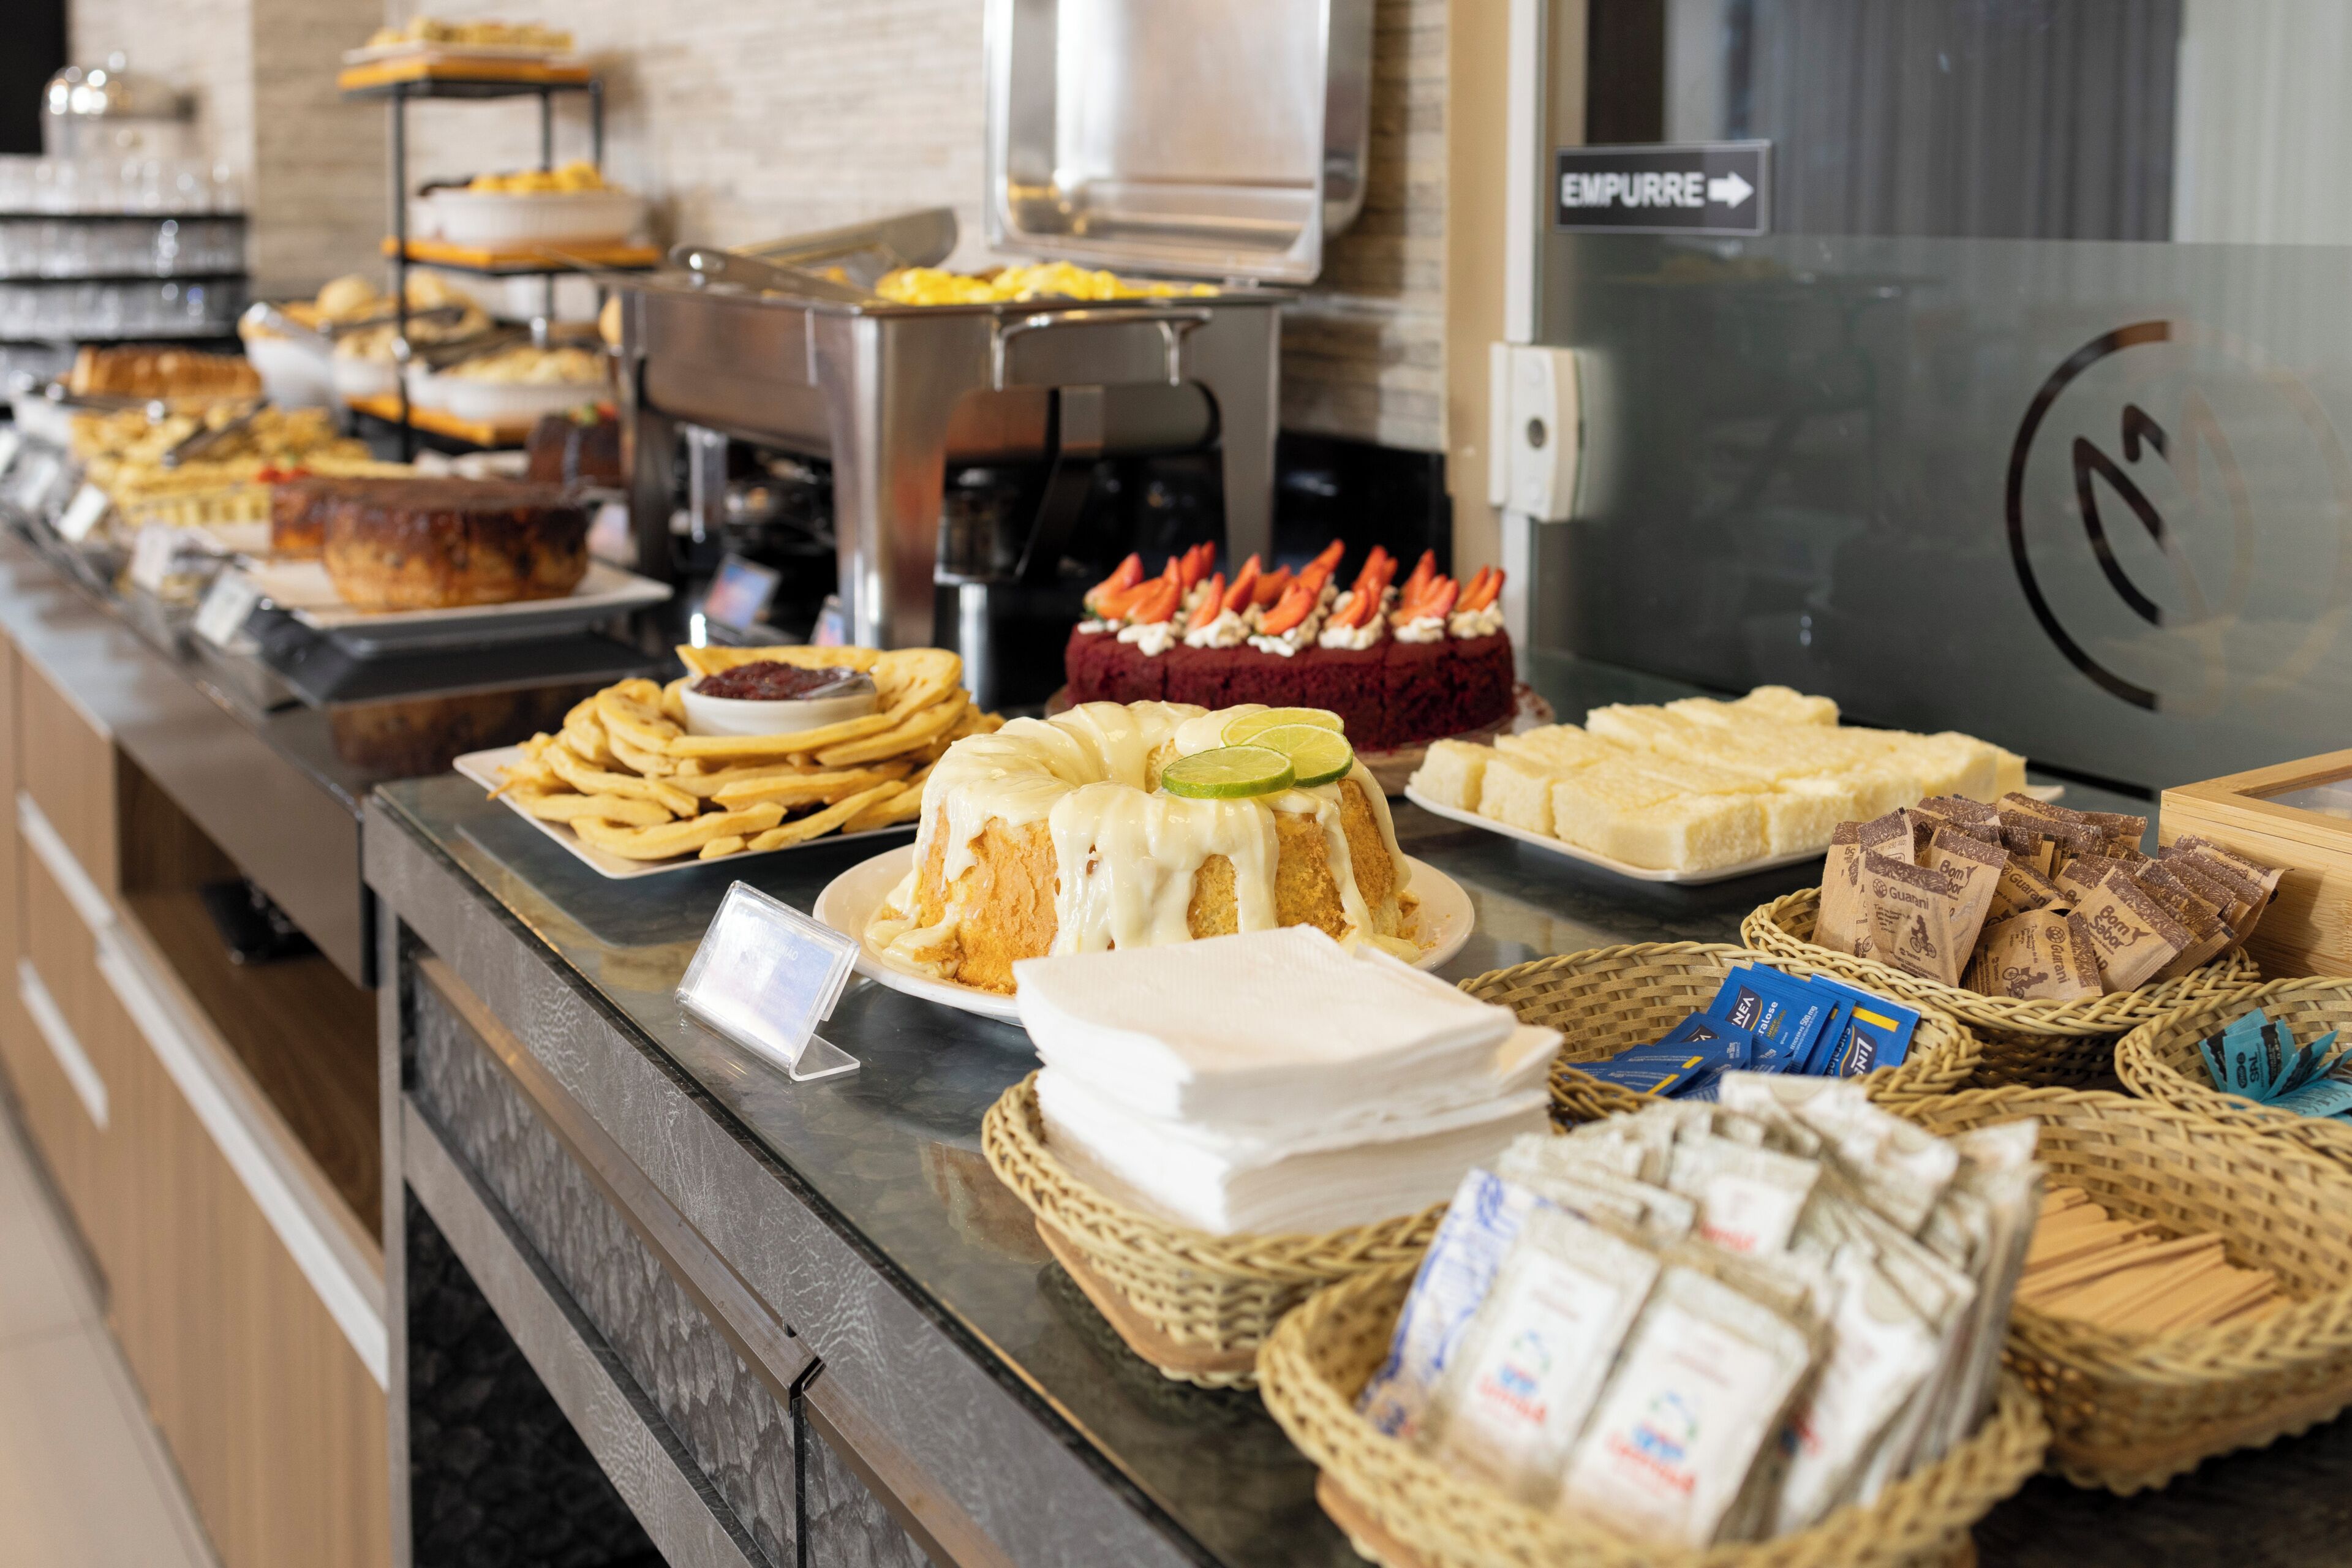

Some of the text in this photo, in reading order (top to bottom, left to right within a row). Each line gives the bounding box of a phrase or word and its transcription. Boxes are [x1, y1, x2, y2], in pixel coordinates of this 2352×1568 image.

[1561, 172, 1705, 208] EMPURRE
[1845, 846, 1855, 856] 5g
[1939, 859, 1964, 880] Bom
[1890, 885, 1929, 910] Guarani
[1947, 878, 1965, 895] bor
[2089, 914, 2125, 949] Sabor
[2100, 905, 2130, 937] Bom
[2050, 943, 2070, 984] Guarani
[1732, 997, 1755, 1028] NEA
[1757, 1001, 1779, 1036] ralose
[1800, 1015, 1811, 1027] 500
[1807, 1005, 1819, 1016] mg
[1826, 1027, 1851, 1076] Sucralos
[1850, 1037, 1874, 1076] LINE
[2248, 1051, 2260, 1084] SAL
